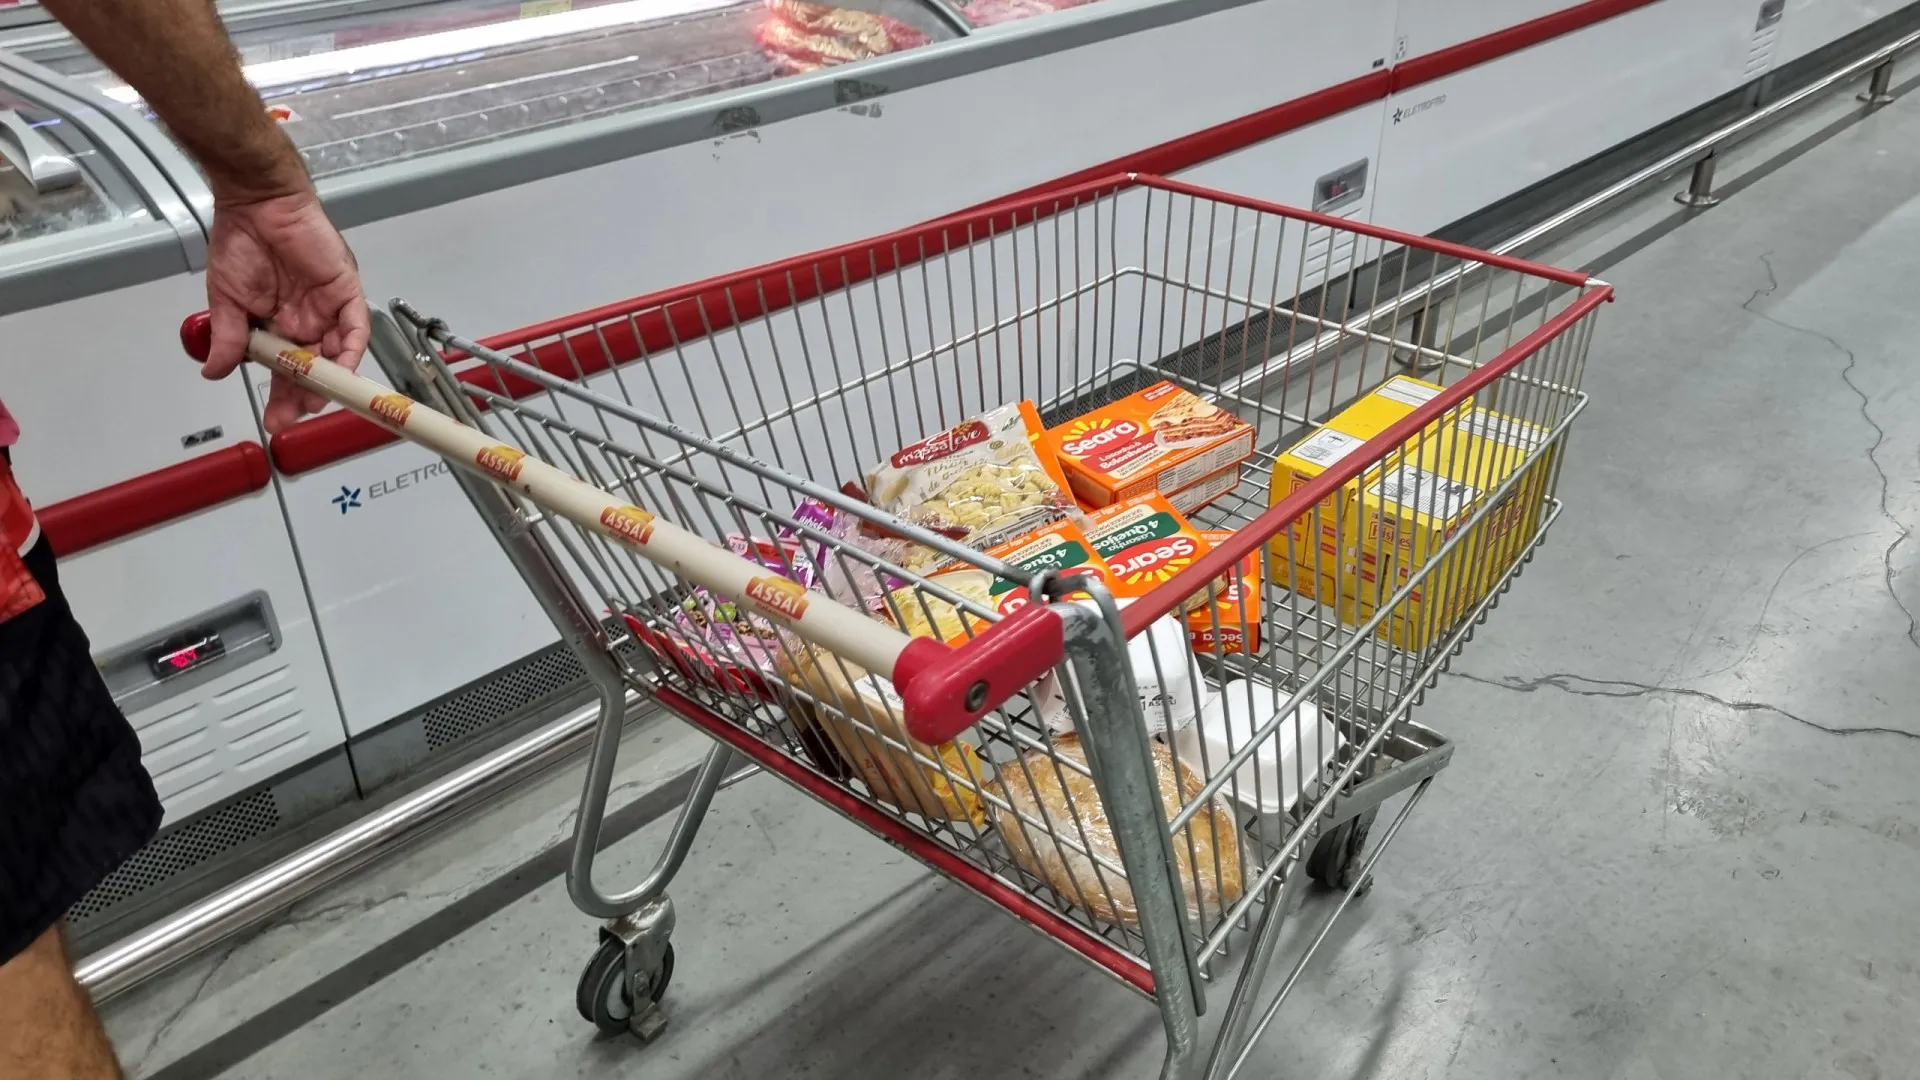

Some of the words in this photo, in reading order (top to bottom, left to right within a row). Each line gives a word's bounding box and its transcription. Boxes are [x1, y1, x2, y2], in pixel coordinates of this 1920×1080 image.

[1063, 421, 1136, 455] Seara
[1099, 445, 1133, 462] Lasanha
[1099, 441, 1156, 470] Bolonhesa
[1148, 520, 1160, 530] 4
[1372, 523, 1411, 547] Fises
[1092, 523, 1149, 552] Queijos
[1107, 531, 1156, 552] Lasanha
[1055, 548, 1068, 559] 4
